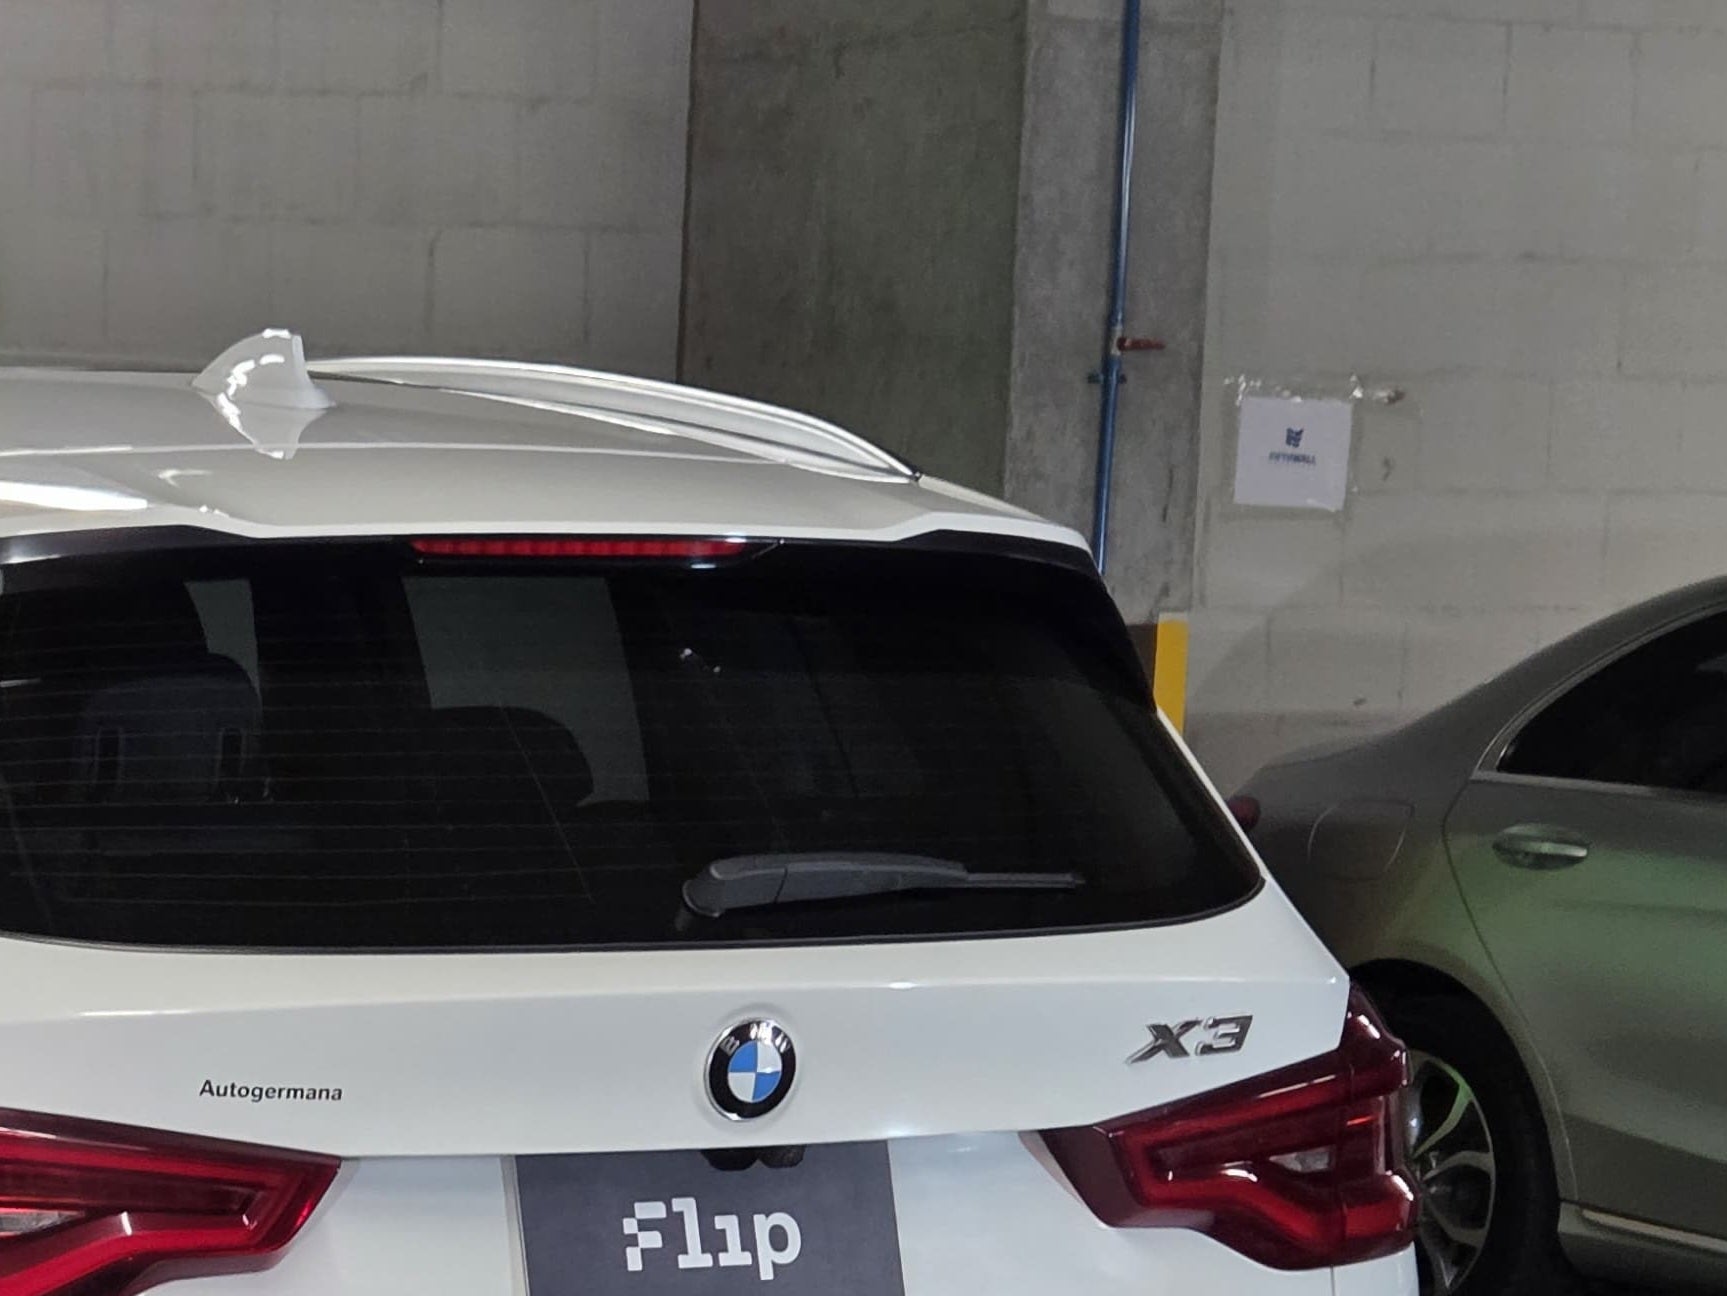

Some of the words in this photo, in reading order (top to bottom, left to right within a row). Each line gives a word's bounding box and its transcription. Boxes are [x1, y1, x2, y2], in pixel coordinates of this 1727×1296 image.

[1125, 1014, 1253, 1065] X3
[199, 1079, 343, 1102] Autogermana
[622, 1197, 802, 1281] Flip
